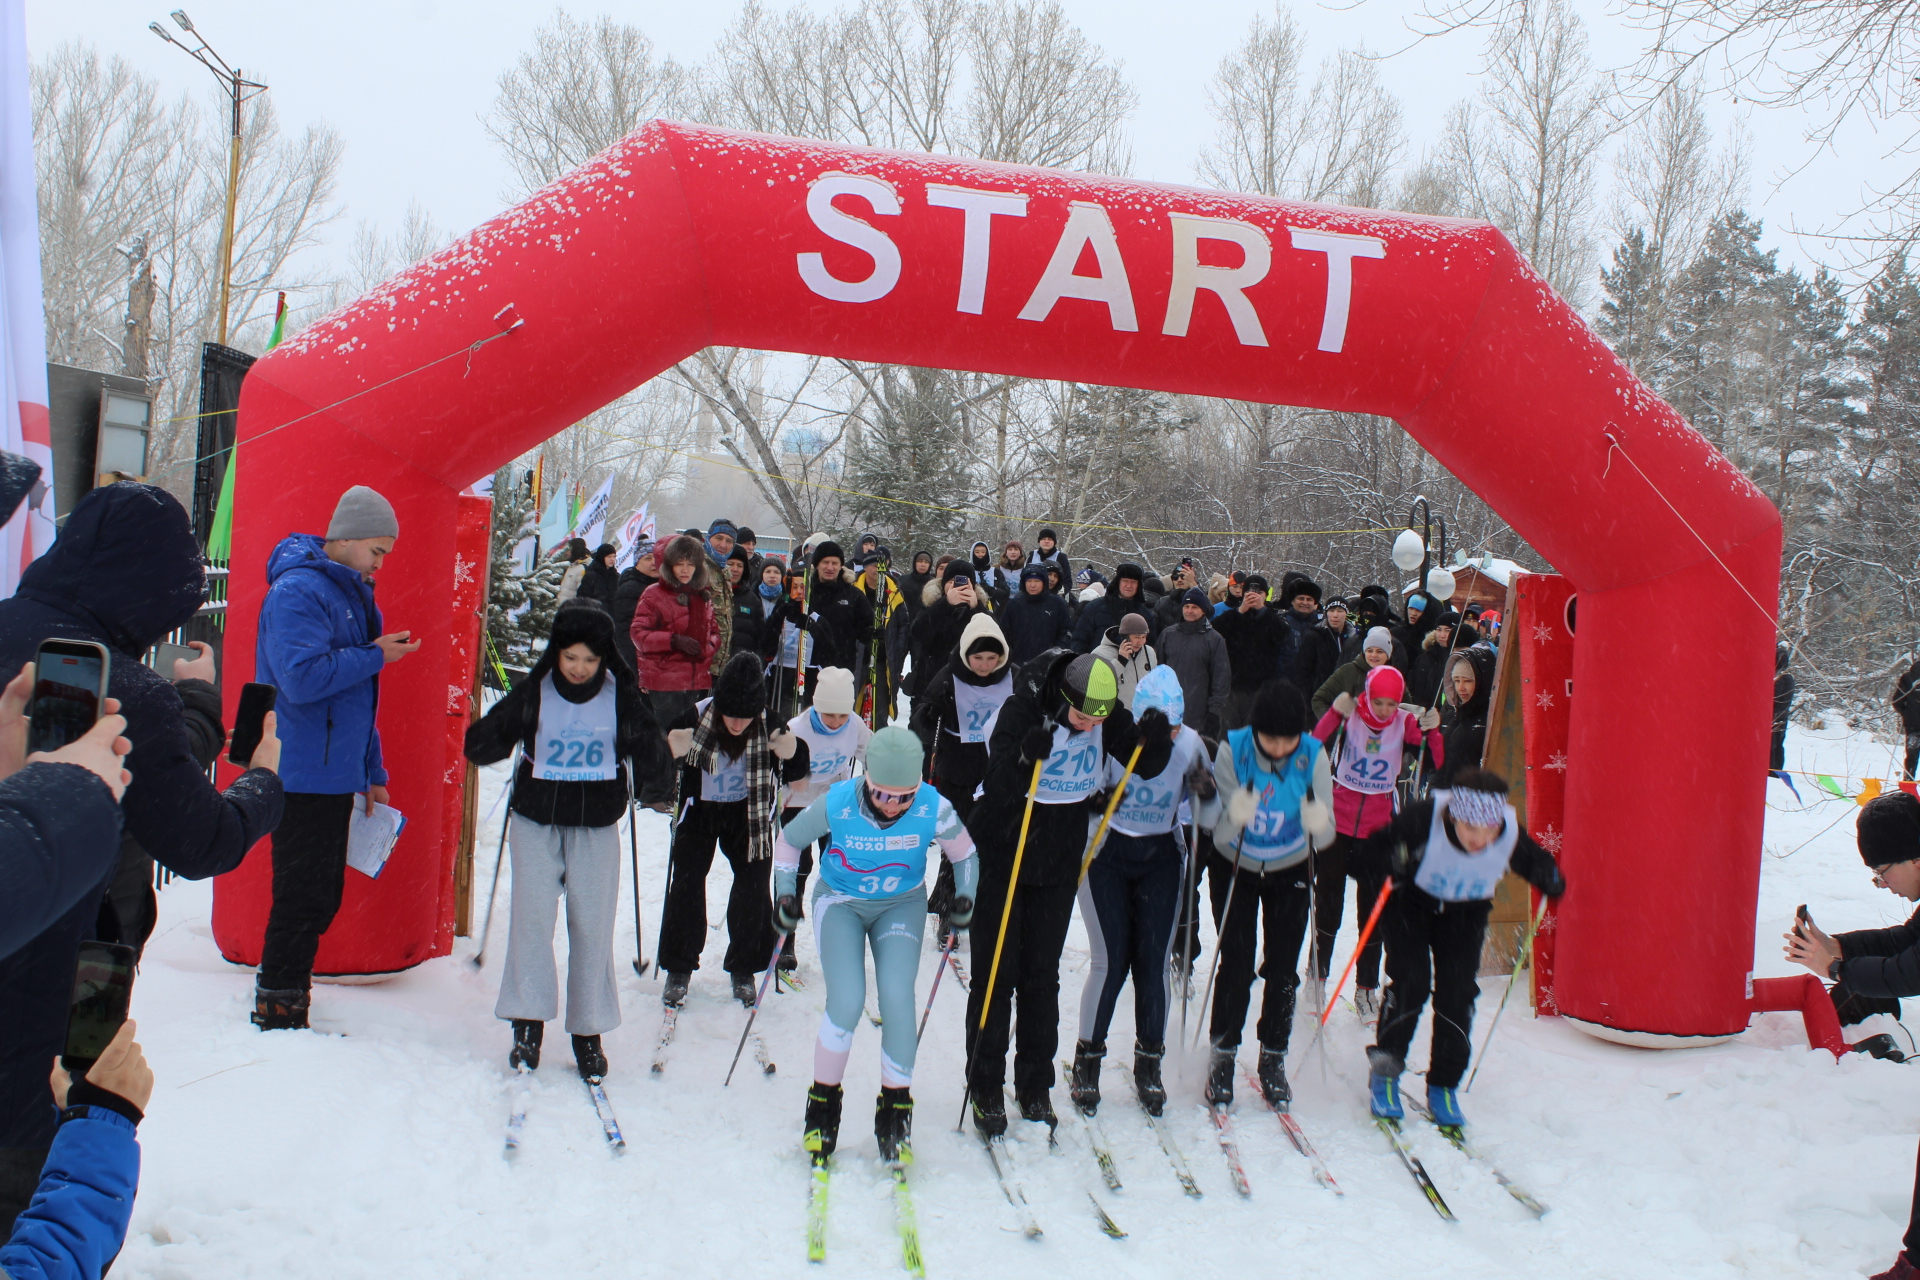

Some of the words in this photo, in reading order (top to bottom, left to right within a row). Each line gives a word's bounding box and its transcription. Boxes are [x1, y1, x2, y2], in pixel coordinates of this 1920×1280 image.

[796, 173, 1385, 353] START
[545, 739, 605, 768] 226
[1043, 745, 1098, 777] 210
[1350, 757, 1389, 781] 42
[1038, 777, 1096, 793] ӨСКЕМЕН
[1344, 774, 1394, 790] ӨСКЕМЕН
[1120, 783, 1173, 810] 294
[1247, 810, 1285, 837] 67
[845, 834, 884, 842] LAUSANNE
[858, 876, 902, 894] 30
